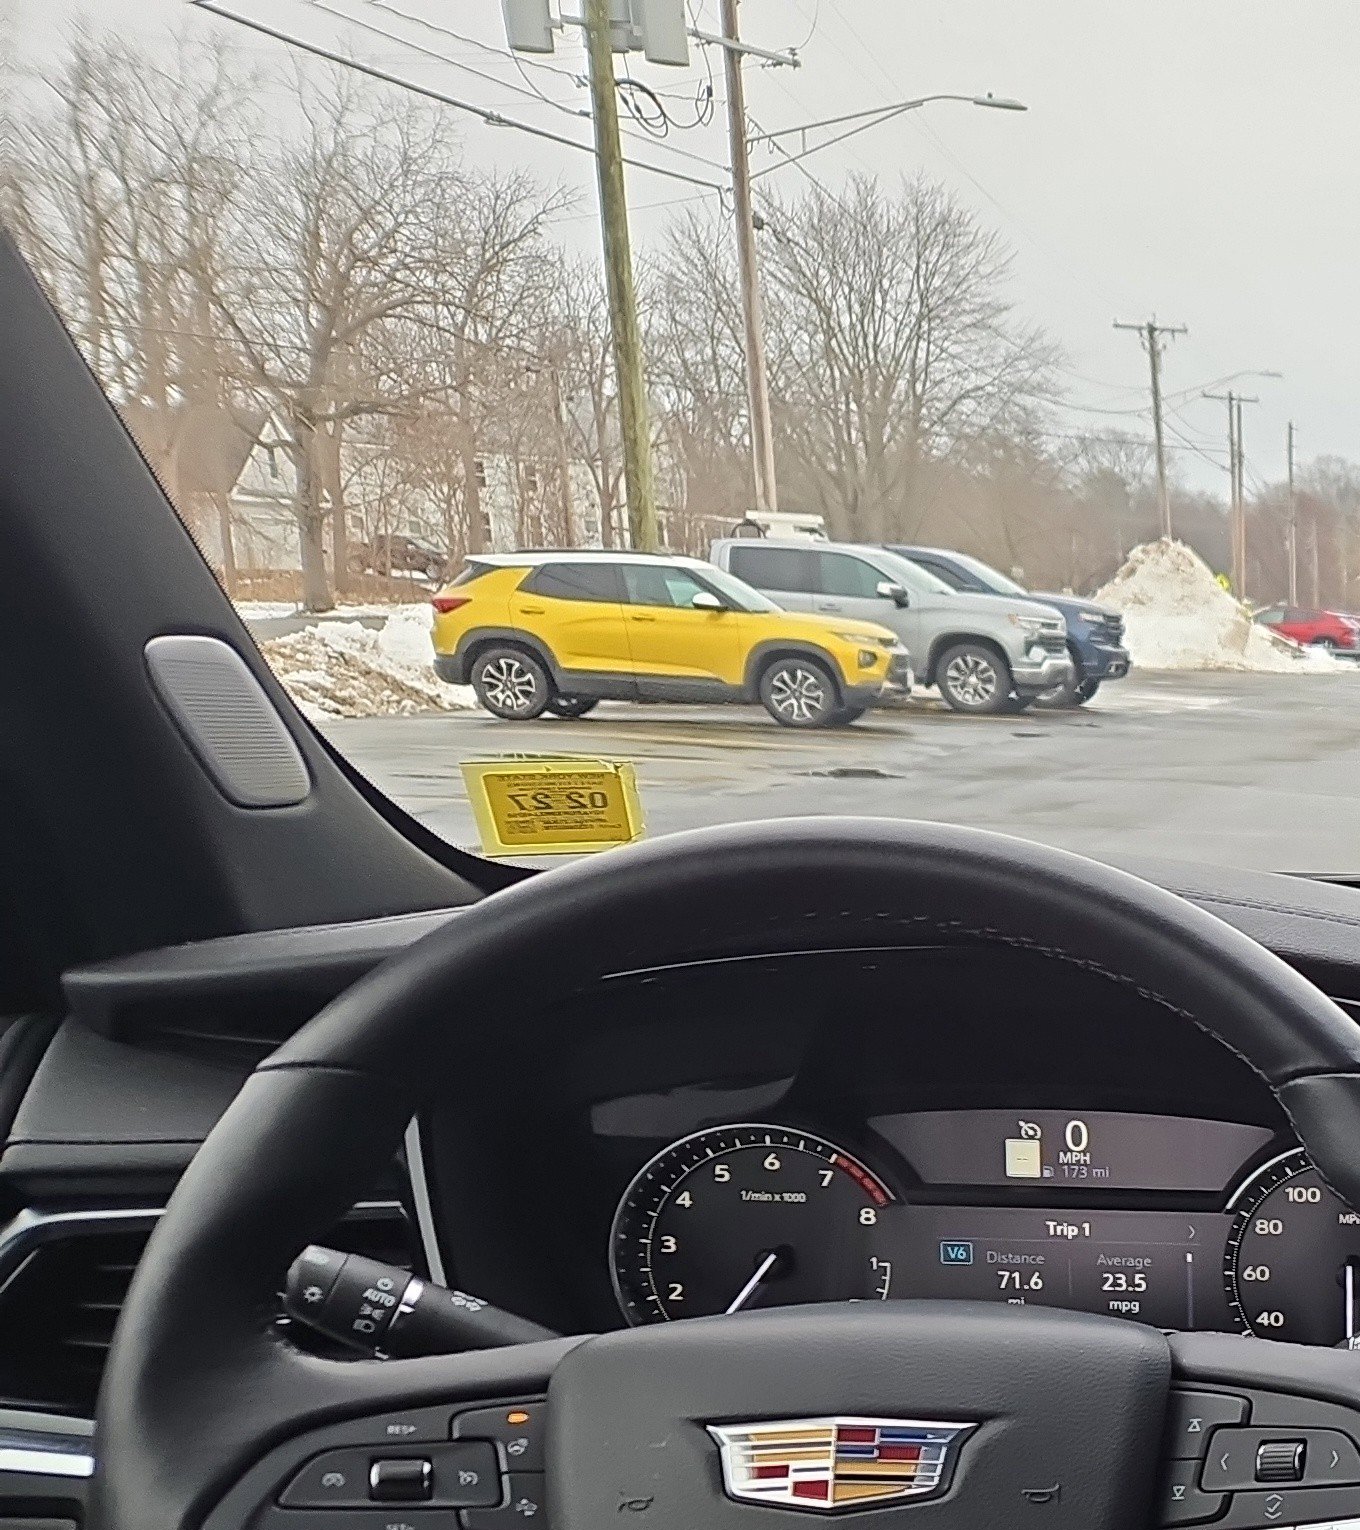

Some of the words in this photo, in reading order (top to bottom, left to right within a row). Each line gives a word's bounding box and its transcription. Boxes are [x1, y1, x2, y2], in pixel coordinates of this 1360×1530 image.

[1065, 1120, 1089, 1152] 0
[763, 1153, 781, 1171] 6
[1059, 1151, 1091, 1165] MPH
[714, 1164, 731, 1183] 5
[818, 1170, 834, 1187] 7
[1062, 1166, 1088, 1179] 173
[1092, 1166, 1111, 1178] mi
[675, 1191, 693, 1208] 4
[1284, 1186, 1321, 1203] 100
[859, 1207, 877, 1225] 8
[1045, 1220, 1079, 1240] Trip
[1082, 1221, 1092, 1237] 1
[1254, 1219, 1283, 1235] 80
[660, 1236, 677, 1253] 3
[947, 1246, 967, 1260] V6
[986, 1251, 1046, 1266] Distance
[1096, 1254, 1152, 1270] Average
[997, 1271, 1043, 1291] 71.6
[1242, 1265, 1271, 1282] 60
[1101, 1273, 1148, 1293] 23.5
[362, 1288, 397, 1308] AUTO
[668, 1284, 684, 1301] 2
[1108, 1301, 1140, 1315] mpg
[1255, 1311, 1284, 1327] 40
